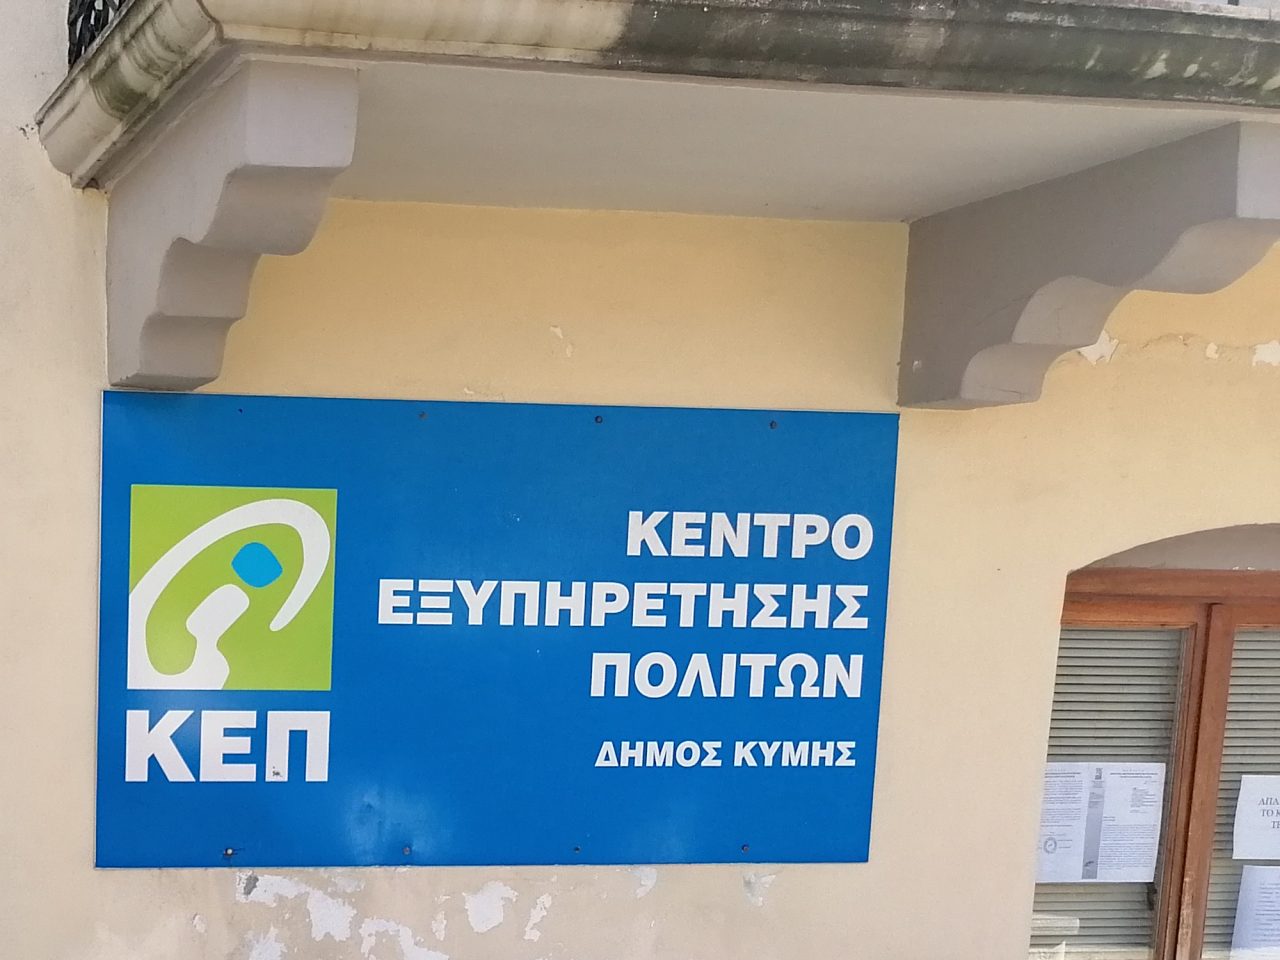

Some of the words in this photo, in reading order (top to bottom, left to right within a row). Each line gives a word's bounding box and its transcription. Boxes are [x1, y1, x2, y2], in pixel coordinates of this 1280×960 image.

[627, 511, 874, 560] ΚΕΝΤΡΟ
[378, 579, 869, 629] ΕΞΥΠΗΡΕΤΗΣΗΣ
[591, 652, 864, 698] ΠΟΛΙΤΩΝ
[126, 710, 331, 782] ΚΕΠ
[595, 741, 722, 767] ΔΗΜΟΣ
[734, 742, 856, 767] ΚΥΜΗΣ
